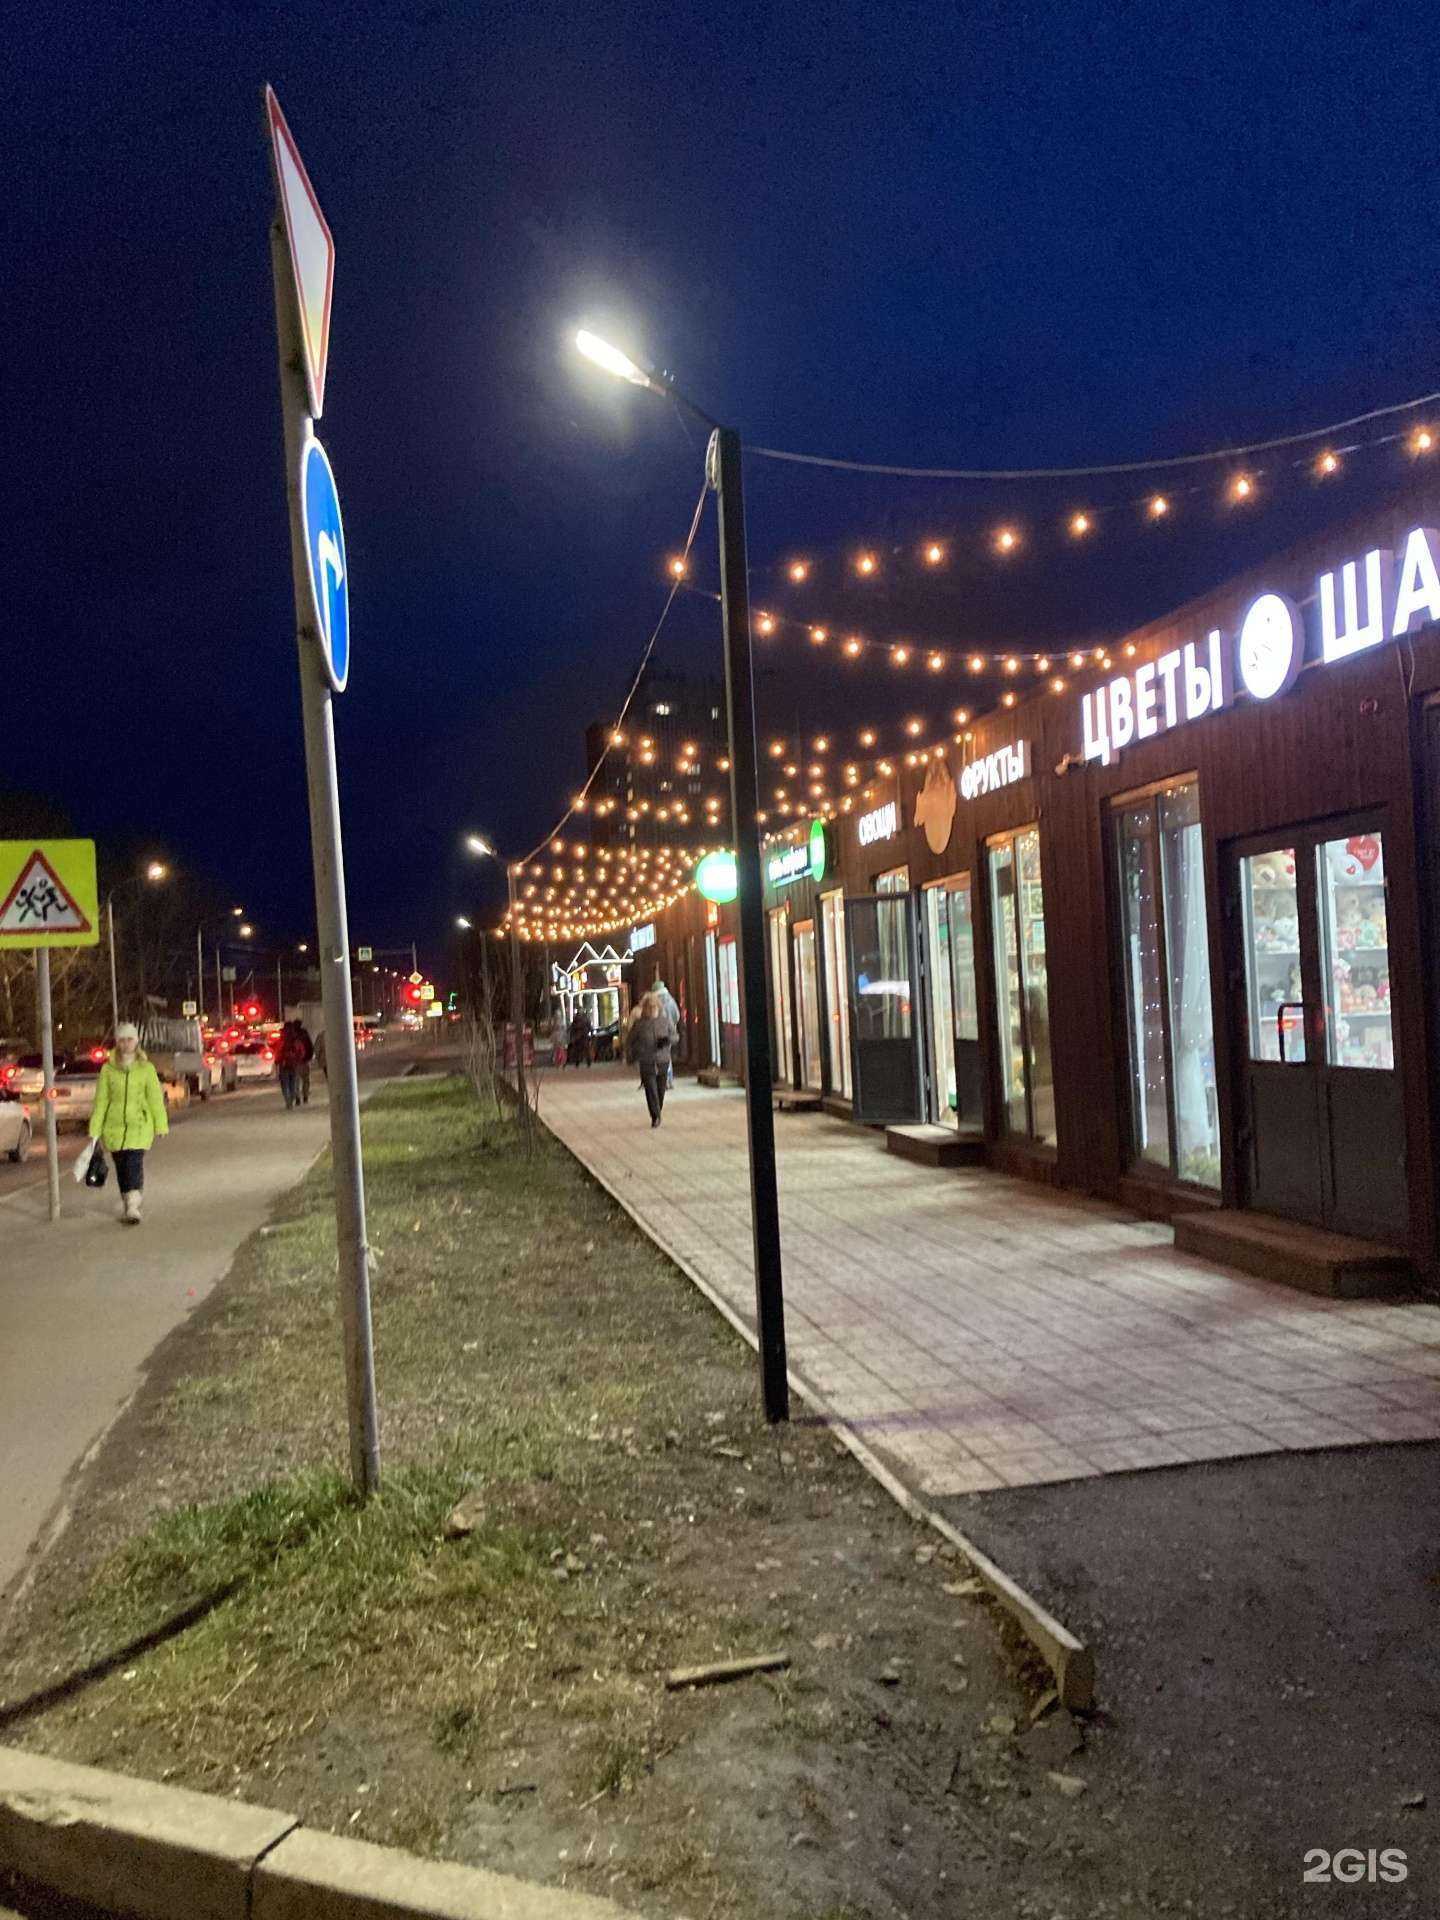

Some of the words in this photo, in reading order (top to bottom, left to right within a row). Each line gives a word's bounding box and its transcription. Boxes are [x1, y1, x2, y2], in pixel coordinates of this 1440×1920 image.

[1082, 628, 1223, 766] ЦВЕТЫ
[1320, 528, 1440, 664] ША
[960, 739, 1024, 800] ФРУКТЫ
